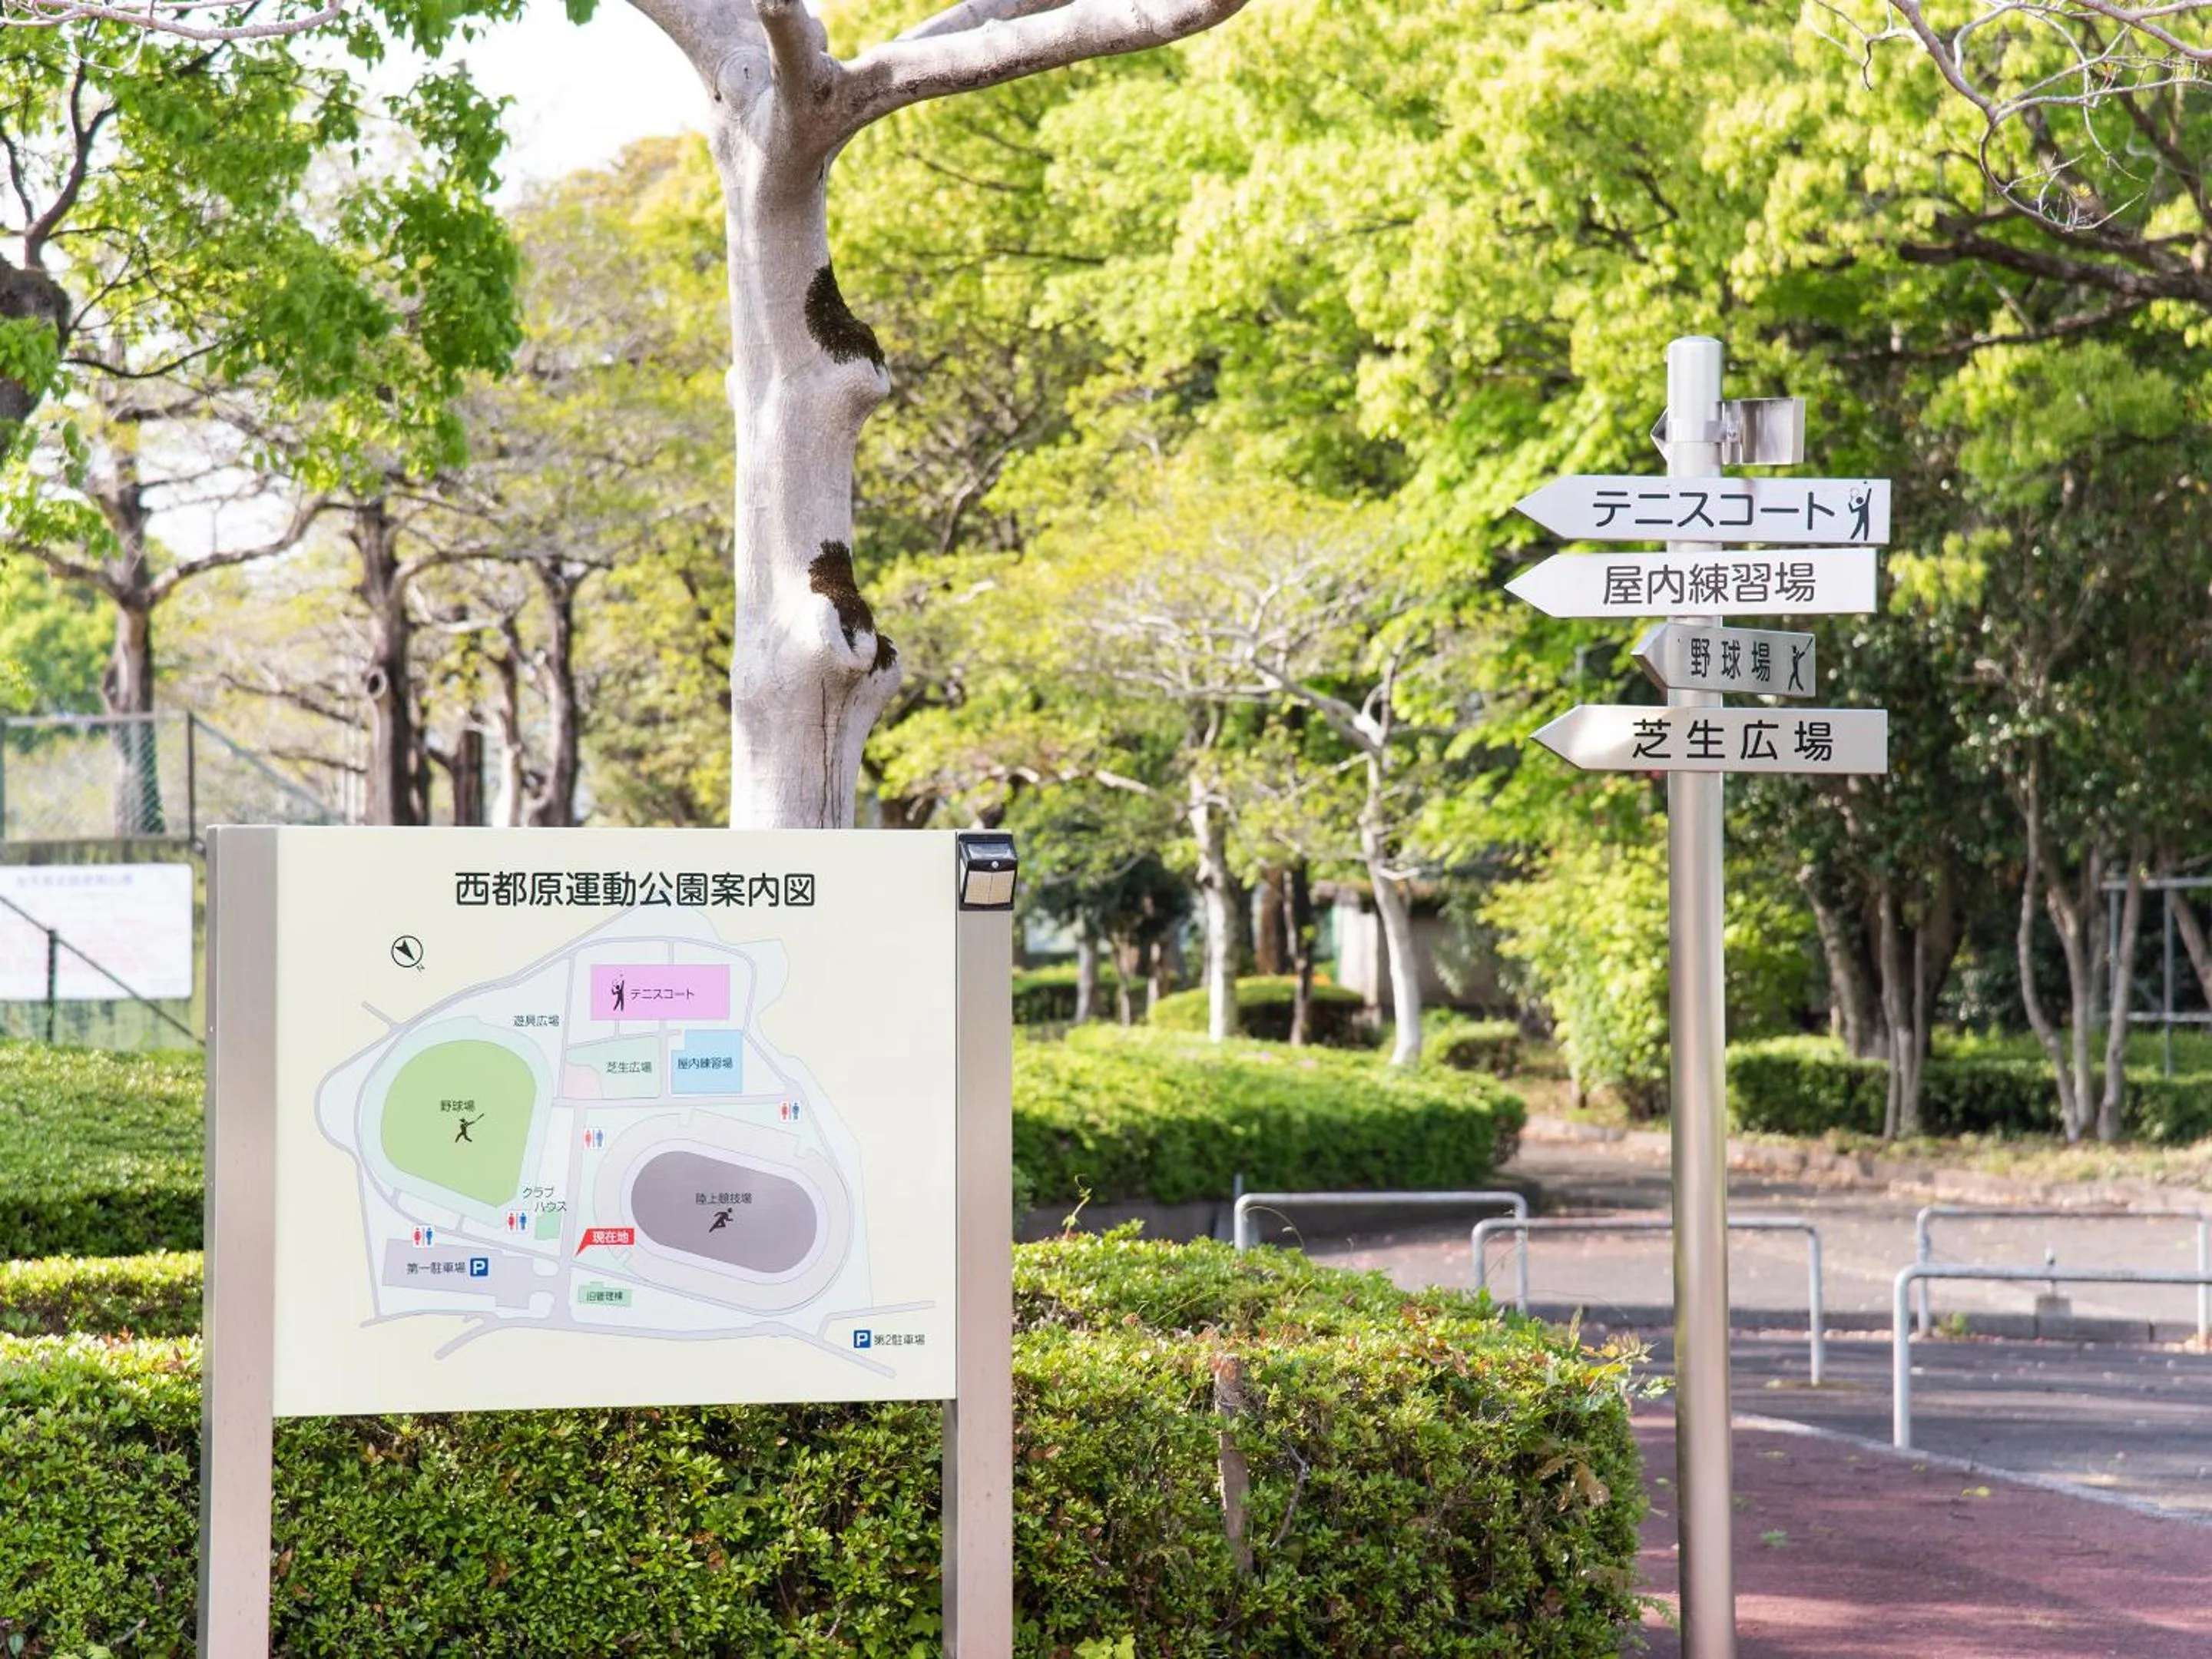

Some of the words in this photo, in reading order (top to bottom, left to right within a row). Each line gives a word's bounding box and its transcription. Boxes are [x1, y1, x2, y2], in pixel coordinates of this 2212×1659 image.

[1592, 490, 1836, 531] テニスコート
[1602, 561, 1817, 605] 屋内練習場
[1690, 637, 1771, 682] 野球場
[1631, 718, 1833, 762] 芝生広場
[455, 871, 816, 908] 西都原運動公園案内図
[630, 987, 696, 1001] テニスコート
[606, 1061, 652, 1074] 芝生広場
[677, 1057, 733, 1070] 屋内練習場
[440, 1099, 475, 1112] 野球場
[695, 1192, 752, 1204] 陸上競技場
[535, 1200, 568, 1213] ハウス
[592, 1230, 629, 1243] 現在地
[406, 1261, 466, 1275] 第一駐車場
[874, 1333, 926, 1346] 第2駐車場
